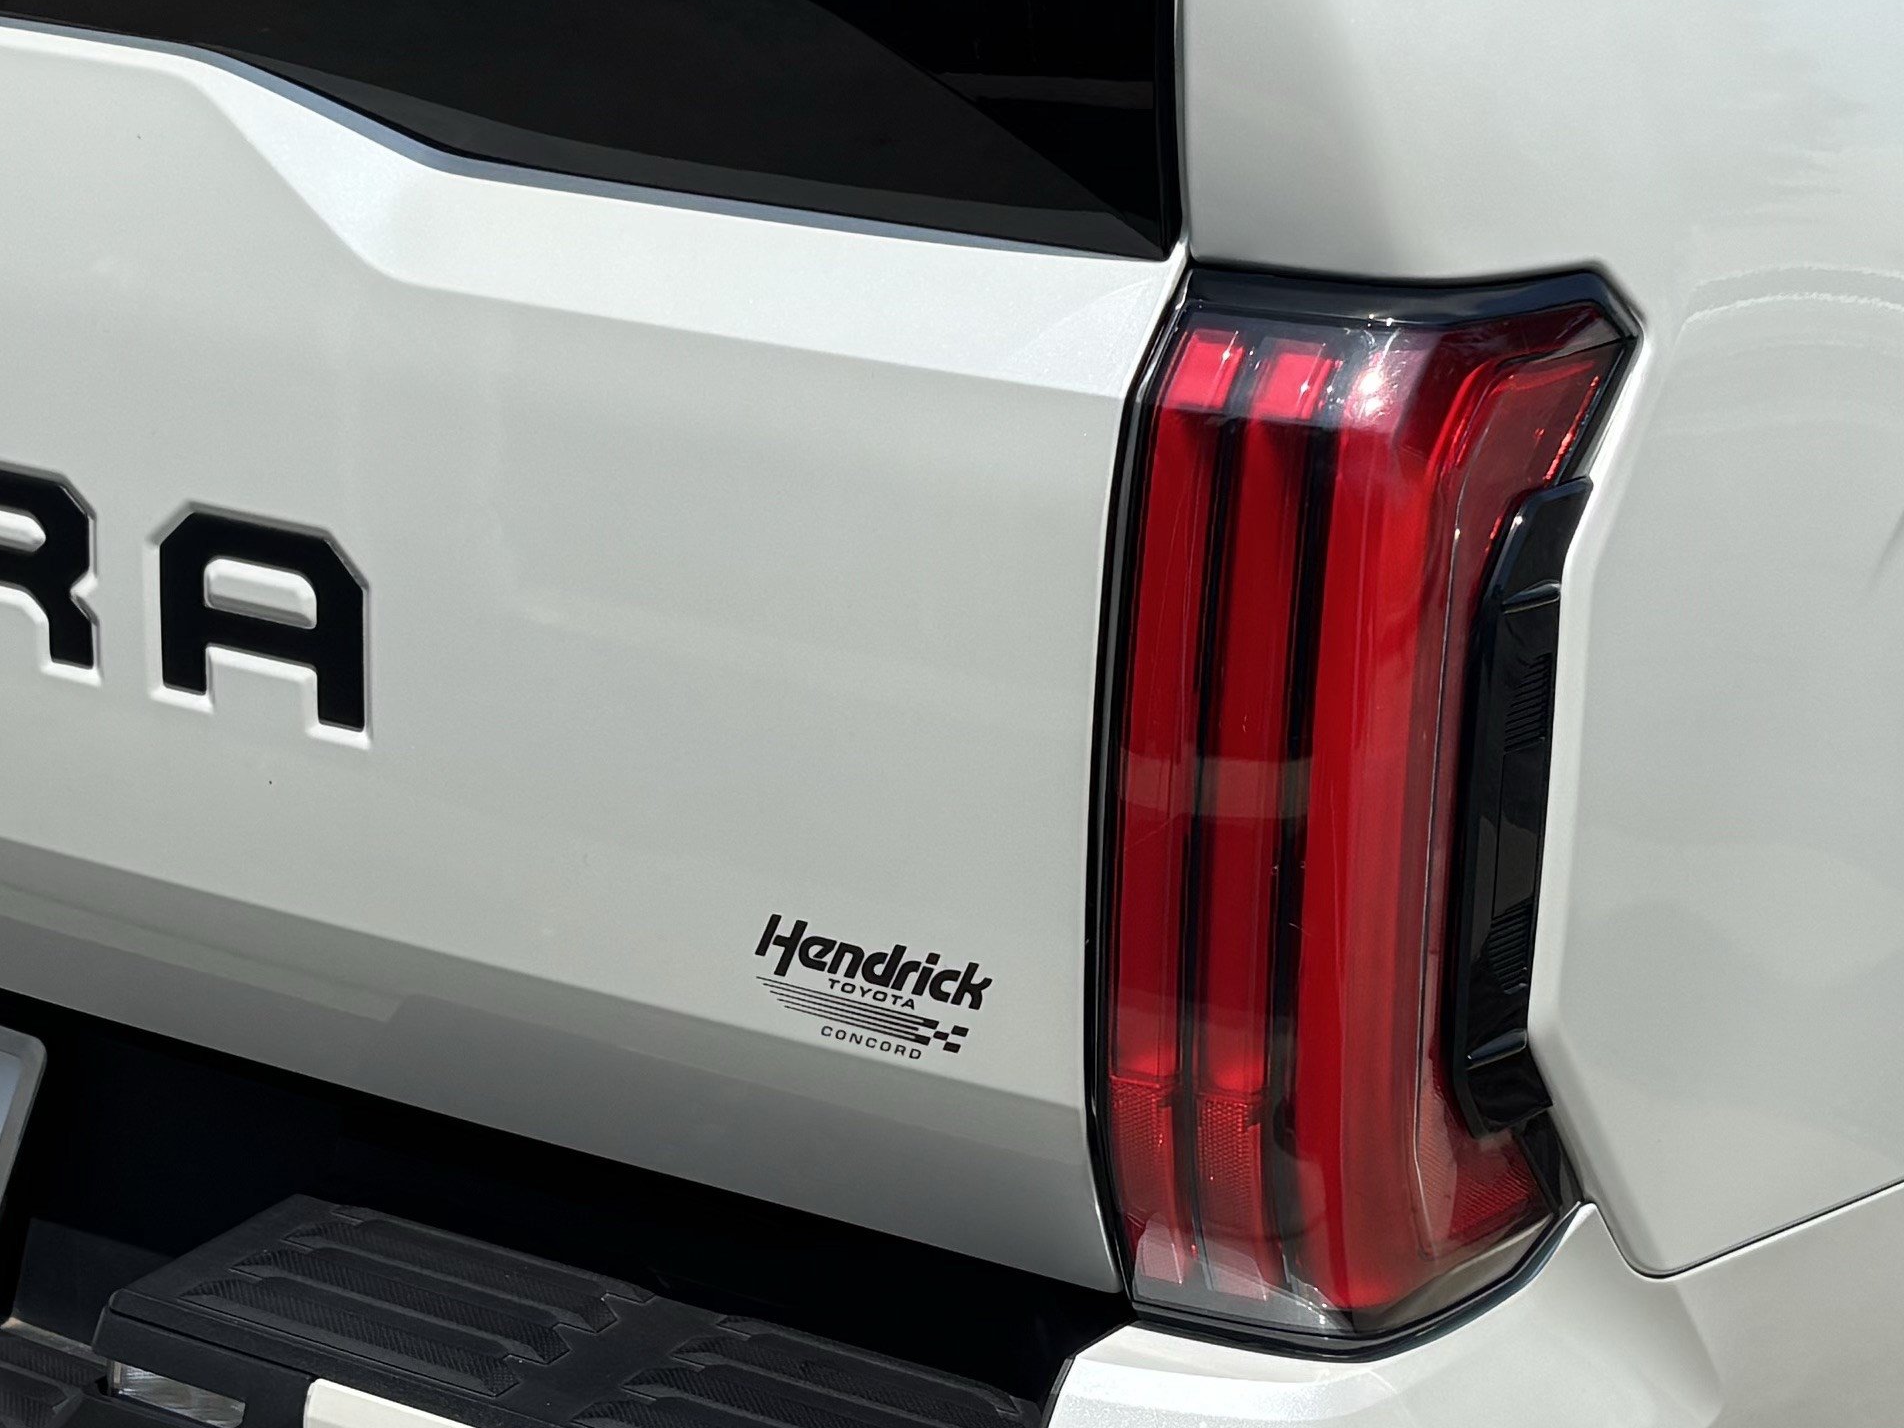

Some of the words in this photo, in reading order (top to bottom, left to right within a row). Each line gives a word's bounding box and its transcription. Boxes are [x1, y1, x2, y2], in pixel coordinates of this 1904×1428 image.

[754, 913, 993, 1011] Hendrick
[828, 978, 916, 1011] TOYOTA
[821, 1025, 922, 1060] CONCORD
